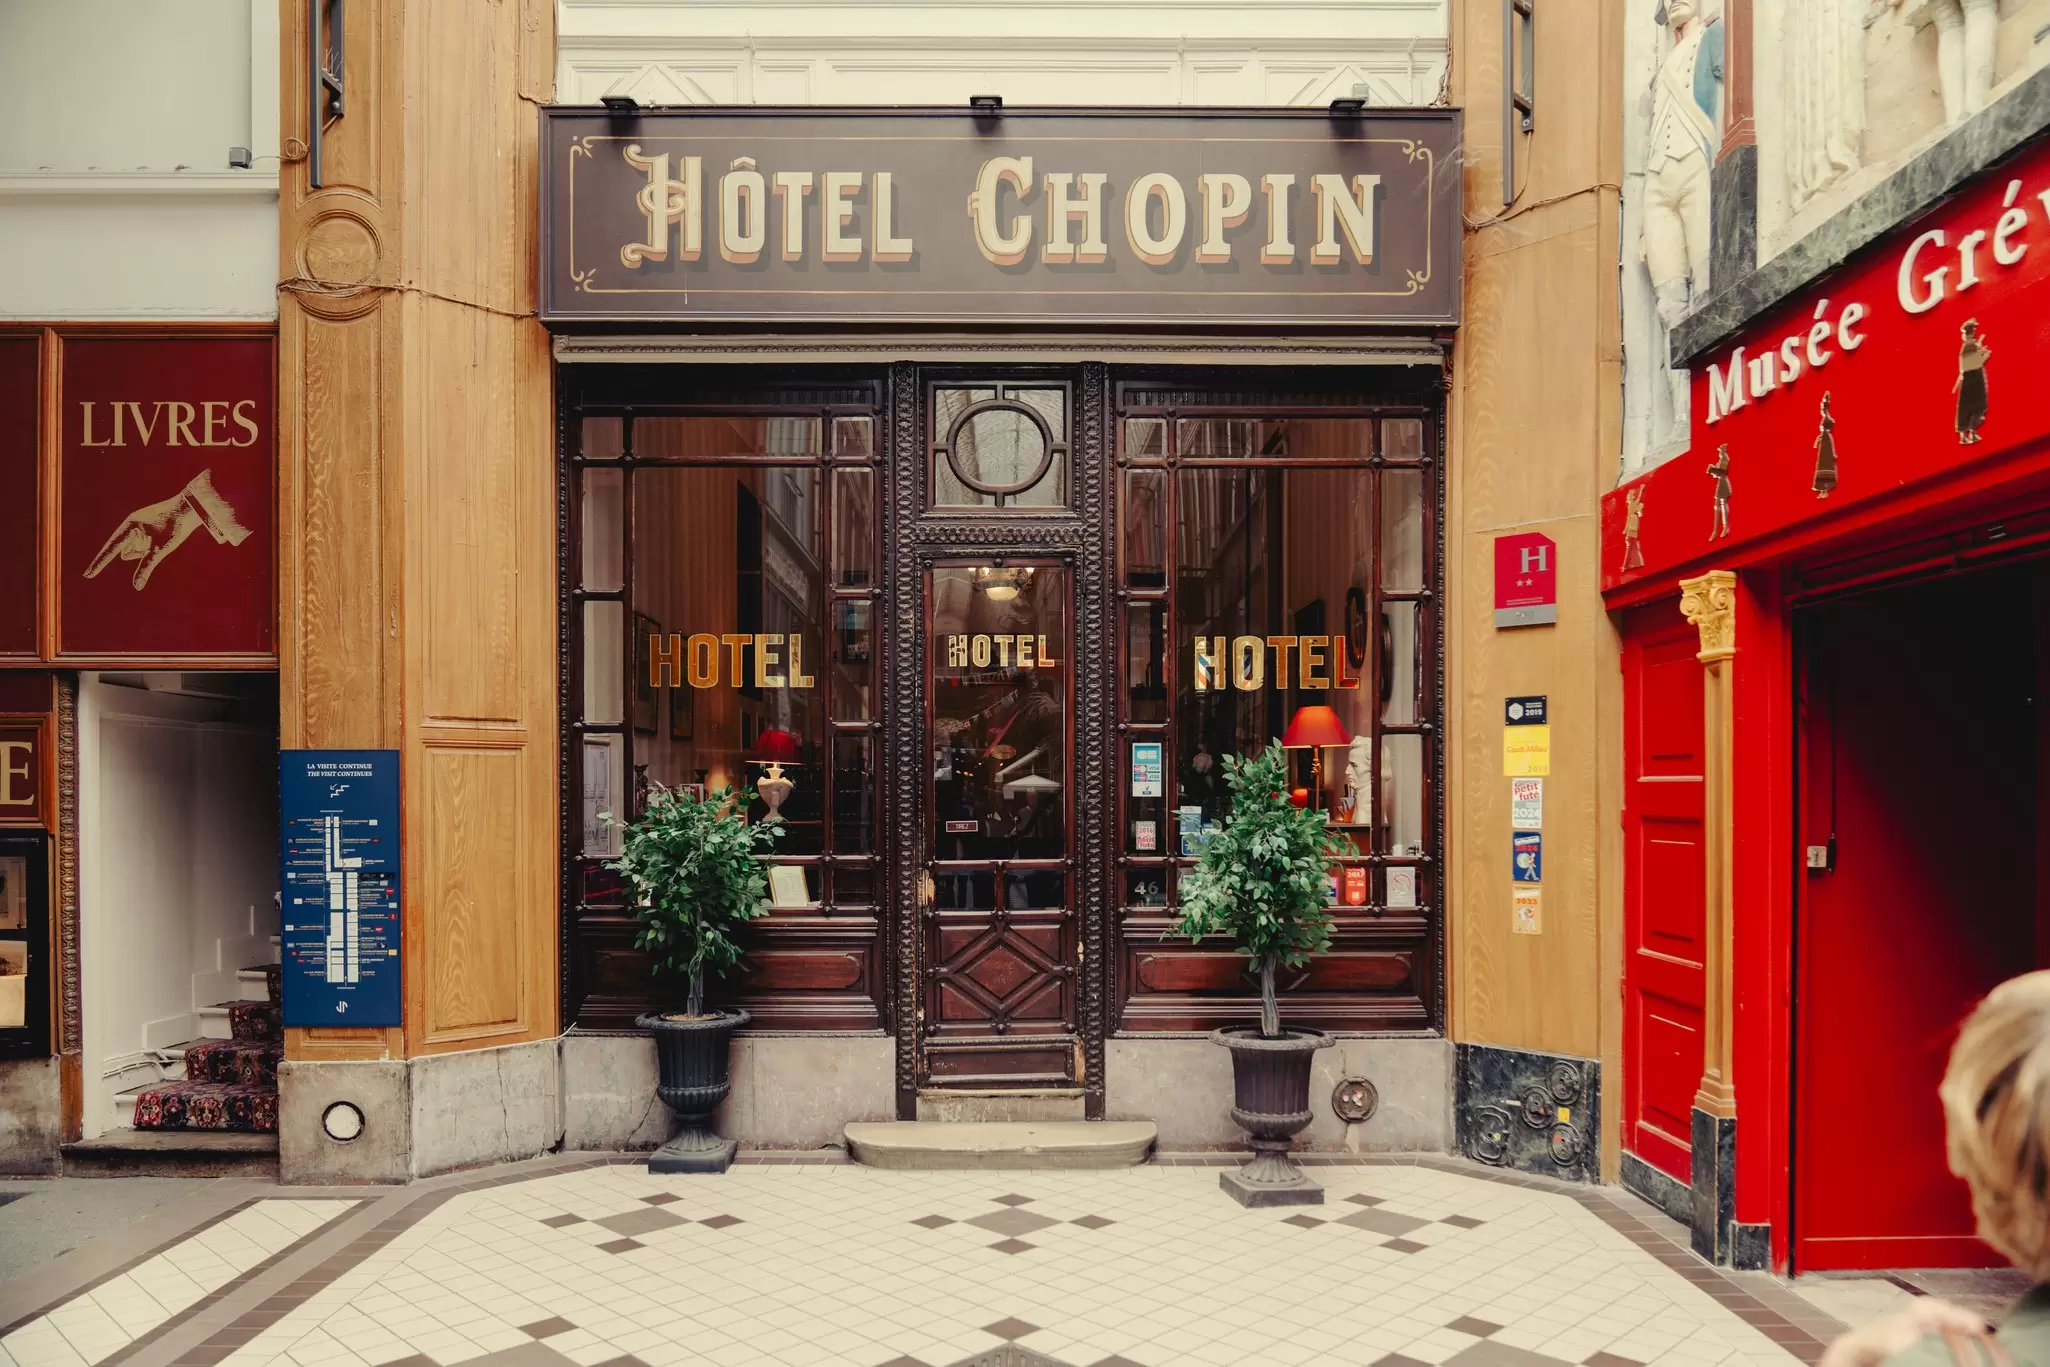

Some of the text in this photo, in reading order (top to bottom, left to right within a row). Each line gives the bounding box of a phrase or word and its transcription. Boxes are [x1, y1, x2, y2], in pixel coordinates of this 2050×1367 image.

[621, 143, 1381, 268] HÔTEL CHOPIN
[1705, 298, 1867, 424] Musée
[79, 399, 259, 447] LIVRES
[1519, 545, 1551, 574] H
[649, 633, 815, 689] HOTEL
[948, 634, 1055, 668] HOTEL
[1194, 635, 1360, 691] HOTEL
[1134, 881, 1159, 895] 46
